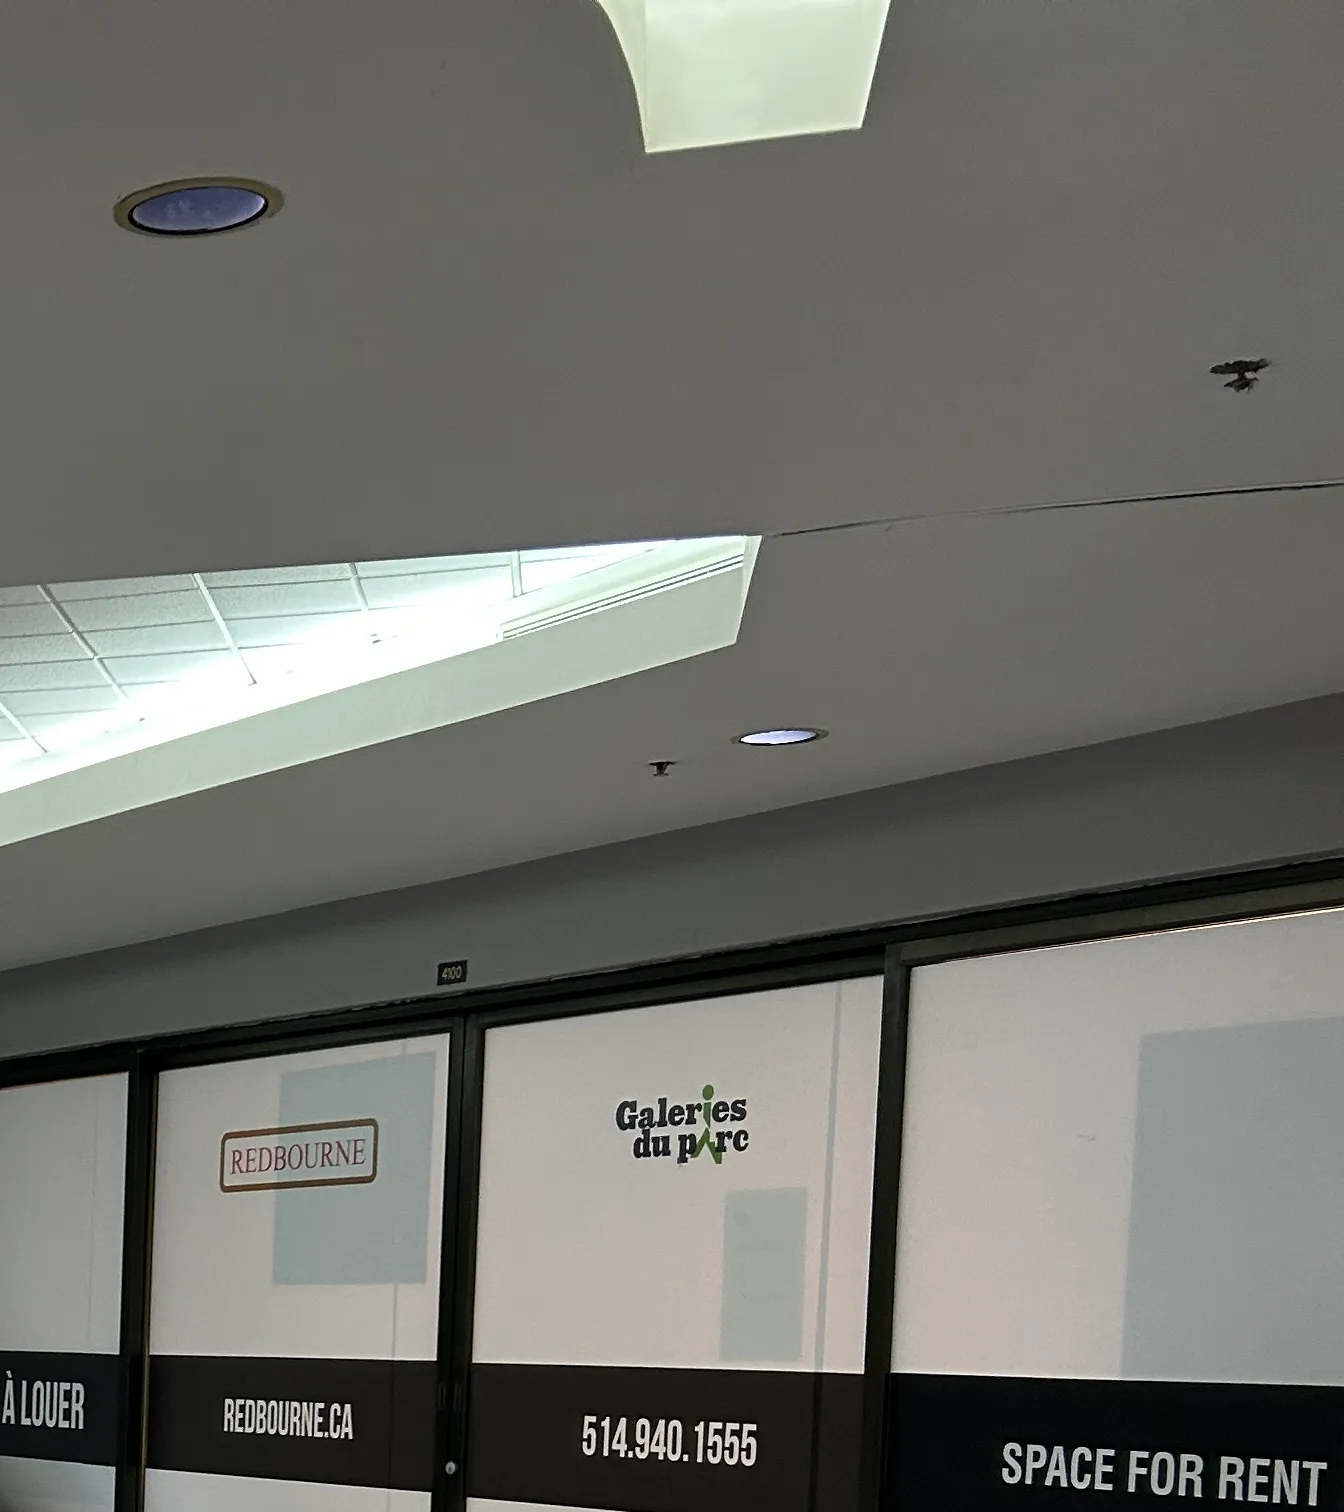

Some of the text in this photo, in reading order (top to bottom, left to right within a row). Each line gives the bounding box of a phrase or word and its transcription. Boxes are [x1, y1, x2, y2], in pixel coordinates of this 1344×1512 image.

[616, 1084, 747, 1131] Galeries
[229, 1137, 366, 1175] REDBOURNE
[633, 1127, 749, 1164] du parc
[1, 1370, 15, 1425] À
[21, 1380, 84, 1429] LOUER
[223, 1397, 354, 1440] REDBOURNE.CA
[582, 1415, 758, 1467] 514.940.1555
[1001, 1442, 1328, 1507] SPACE FOR RENT
